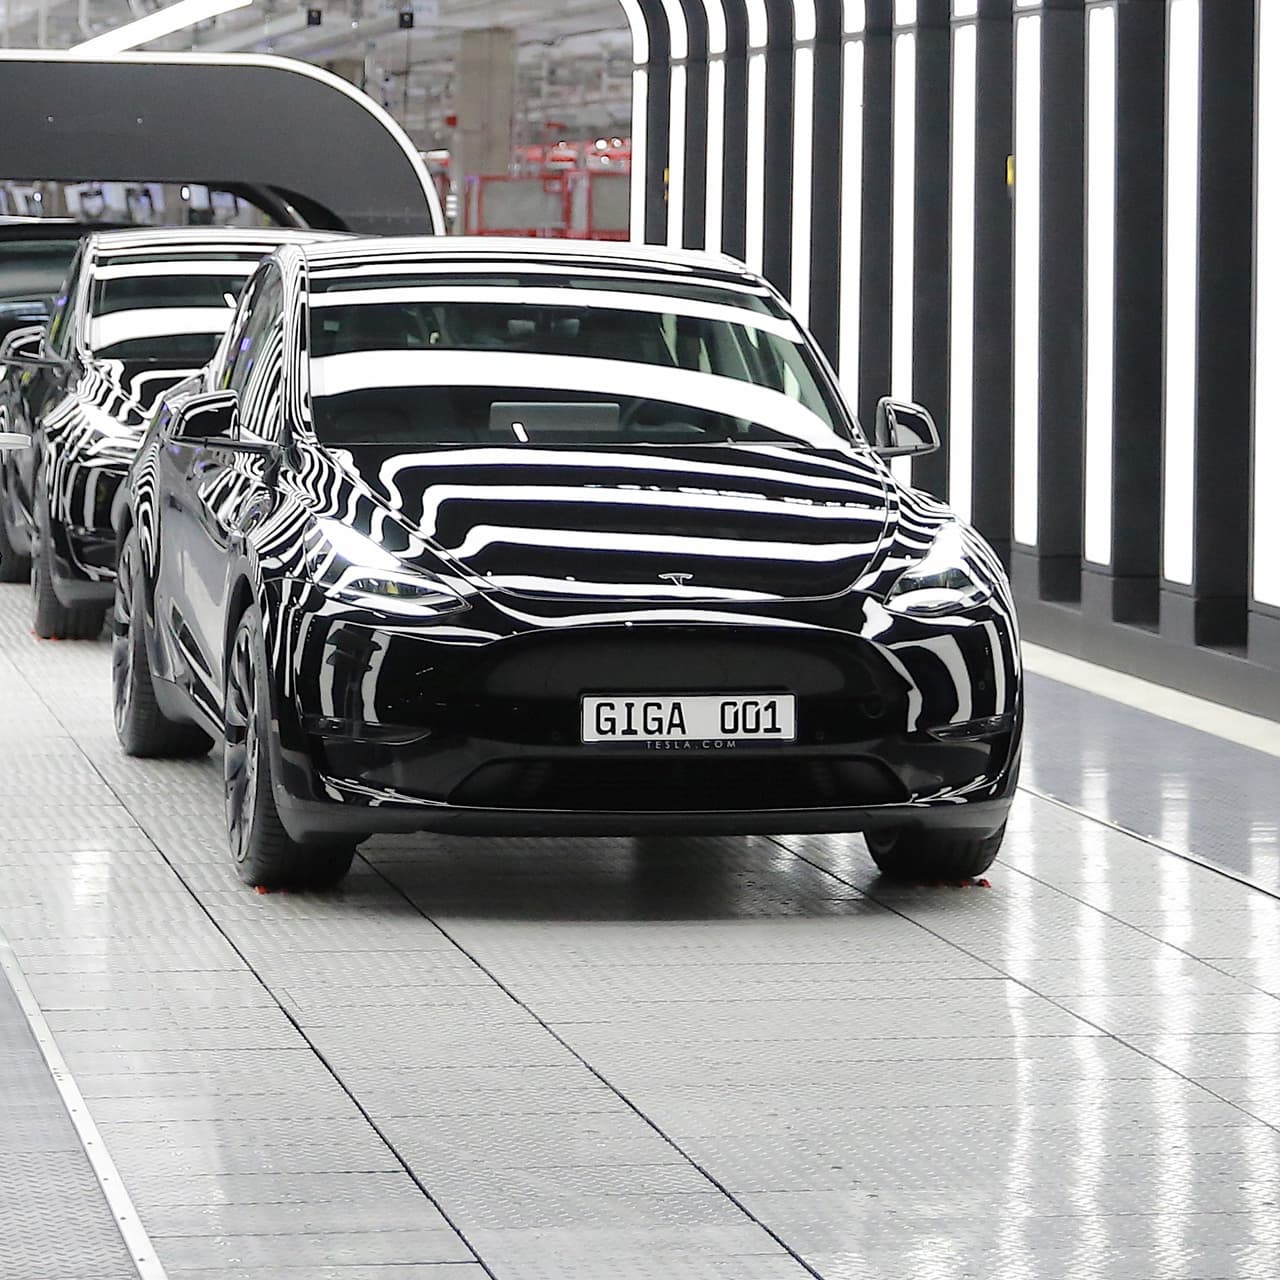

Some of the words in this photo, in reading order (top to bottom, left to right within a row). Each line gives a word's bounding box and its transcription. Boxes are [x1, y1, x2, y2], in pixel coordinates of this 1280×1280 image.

[594, 702, 687, 736] GIGA
[719, 700, 782, 735] 001
[646, 740, 737, 750] TESLA.COM
